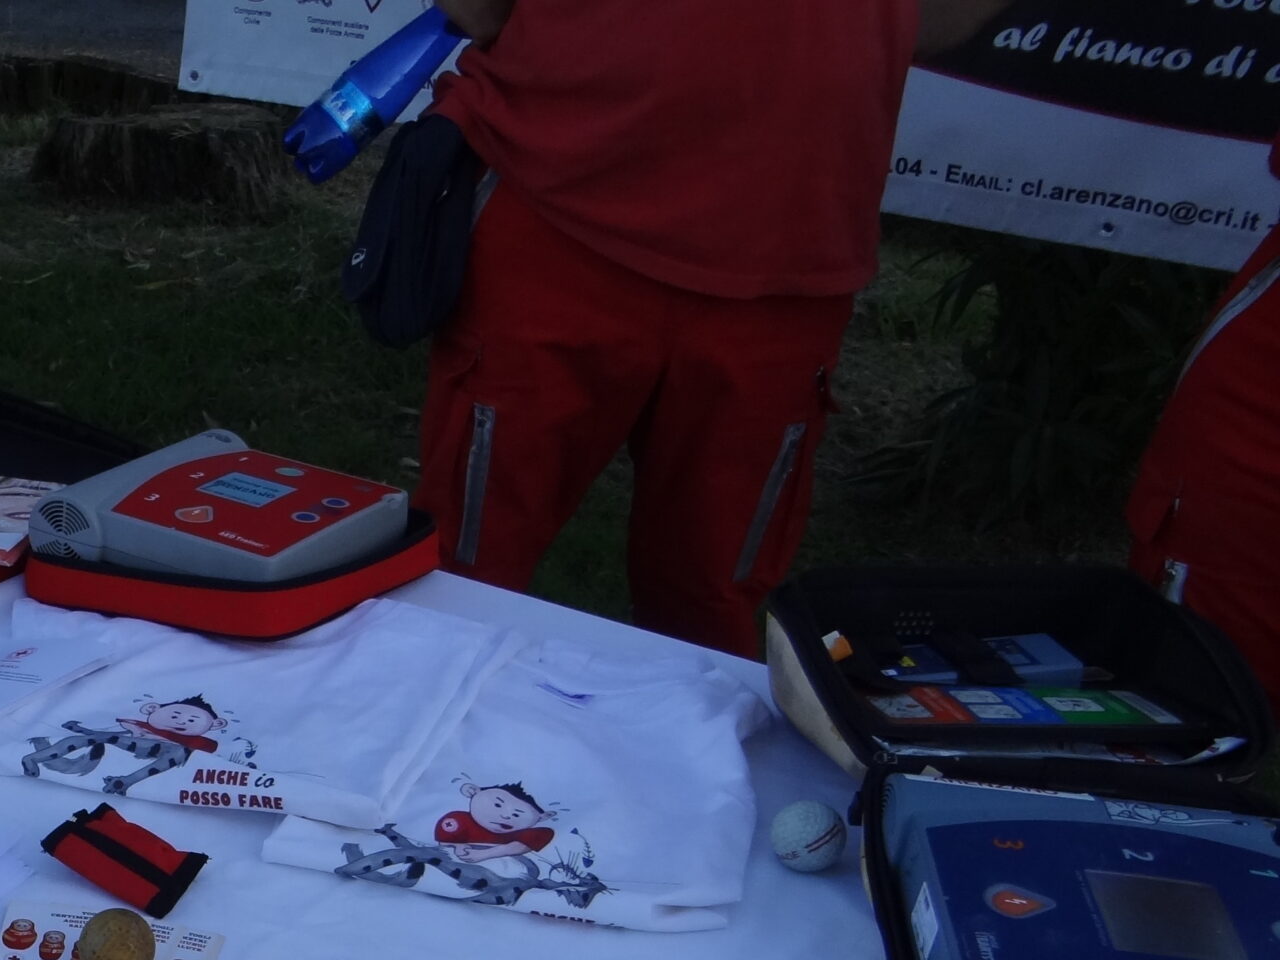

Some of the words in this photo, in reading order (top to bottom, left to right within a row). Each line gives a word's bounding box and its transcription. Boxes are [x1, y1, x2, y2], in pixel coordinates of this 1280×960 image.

[992, 22, 1050, 52] al
[1052, 27, 1194, 71] fianco
[1203, 46, 1258, 80] di
[1021, 177, 1261, 233] cl.arenzano@cri.it
[144, 493, 161, 502] 3
[192, 768, 251, 787] ANCHE
[180, 789, 232, 806] POSSO
[238, 792, 285, 810] FARE
[992, 836, 1025, 852] 3
[1121, 847, 1155, 862] 2
